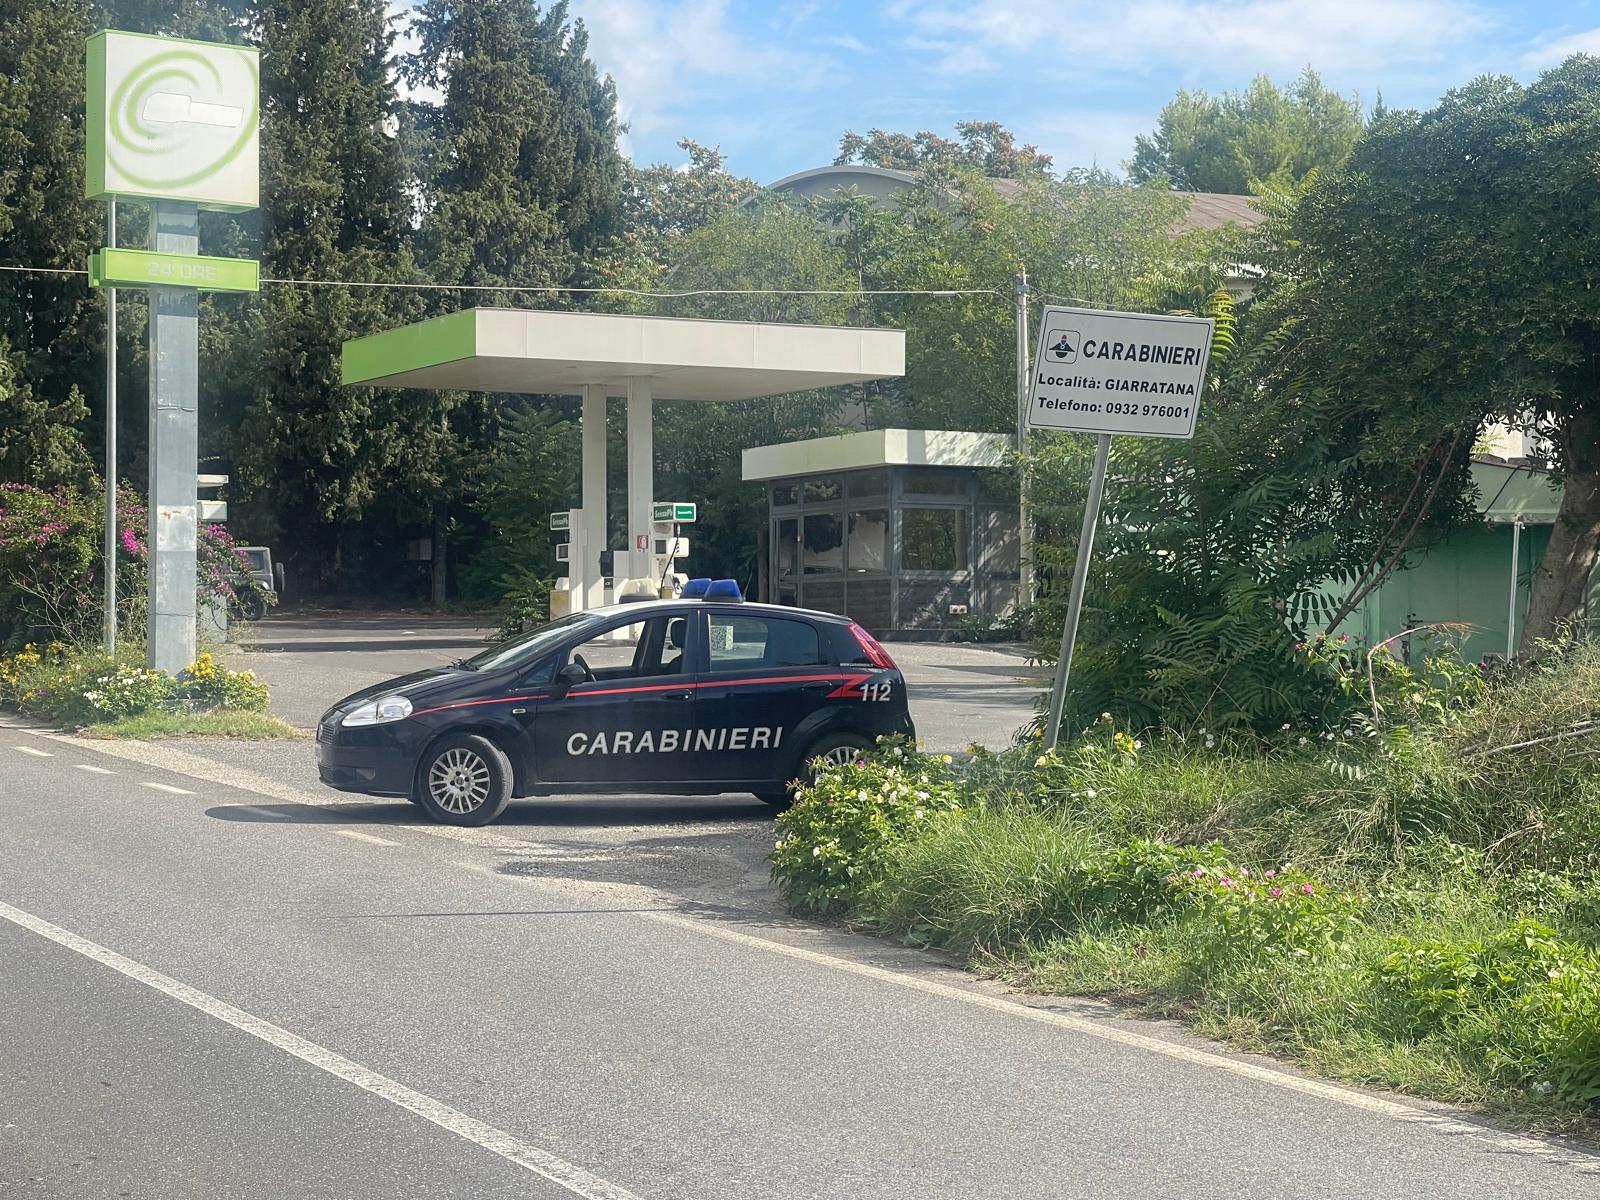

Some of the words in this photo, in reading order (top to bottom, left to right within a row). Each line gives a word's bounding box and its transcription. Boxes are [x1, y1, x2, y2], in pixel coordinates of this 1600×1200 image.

[1083, 340, 1201, 366] CARABINIERI
[1038, 373, 1101, 389] Località:
[1105, 378, 1195, 395] GIARRATANA
[1038, 397, 1102, 413] Telefono:
[1106, 402, 1138, 415] 0932
[1142, 406, 1190, 418] 976001
[860, 683, 892, 702] 112
[566, 726, 783, 756] CARABINIERI
